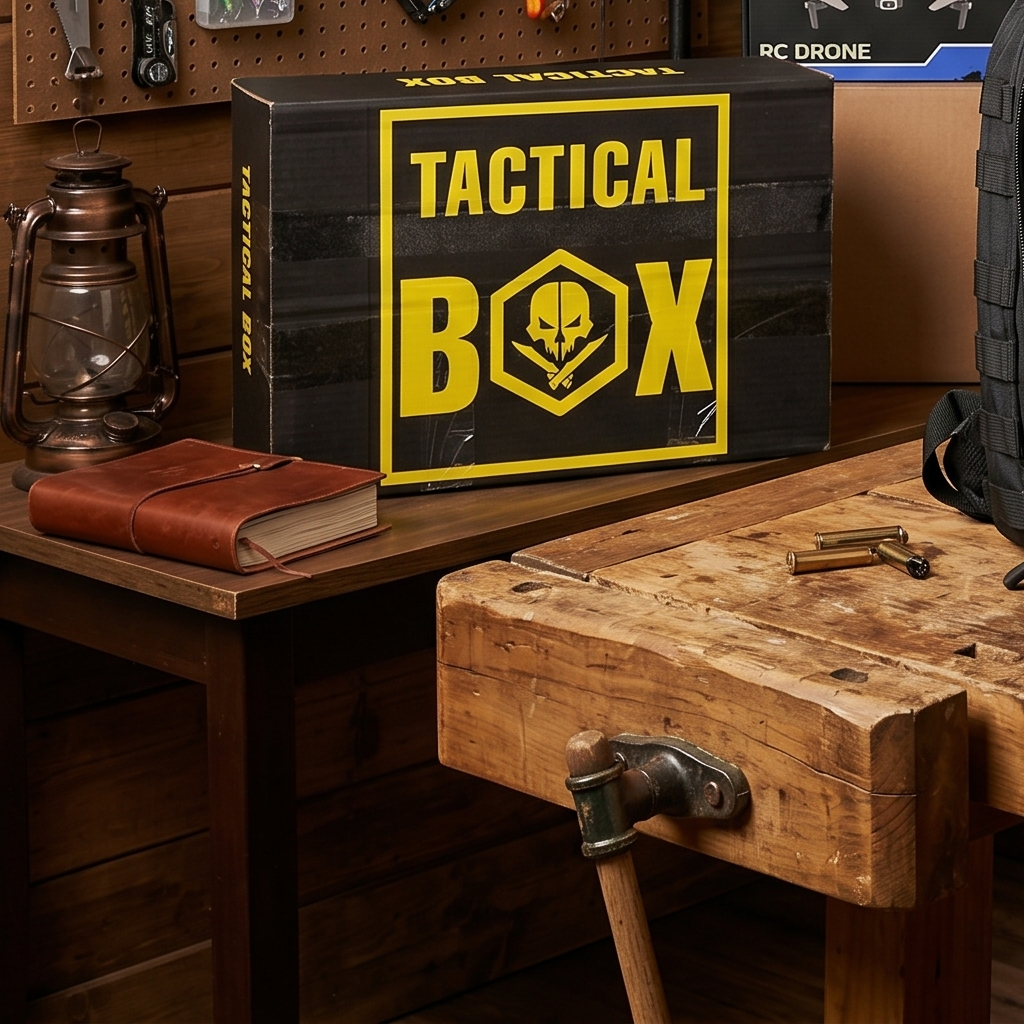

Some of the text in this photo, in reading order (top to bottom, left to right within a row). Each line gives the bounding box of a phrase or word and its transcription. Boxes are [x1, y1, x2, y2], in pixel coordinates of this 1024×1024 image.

[396, 66, 685, 87] TACTICAL BOX
[759, 43, 872, 60] RC DRONE
[410, 138, 706, 219] TACTICAL
[241, 166, 252, 376] TACTICAL BOX
